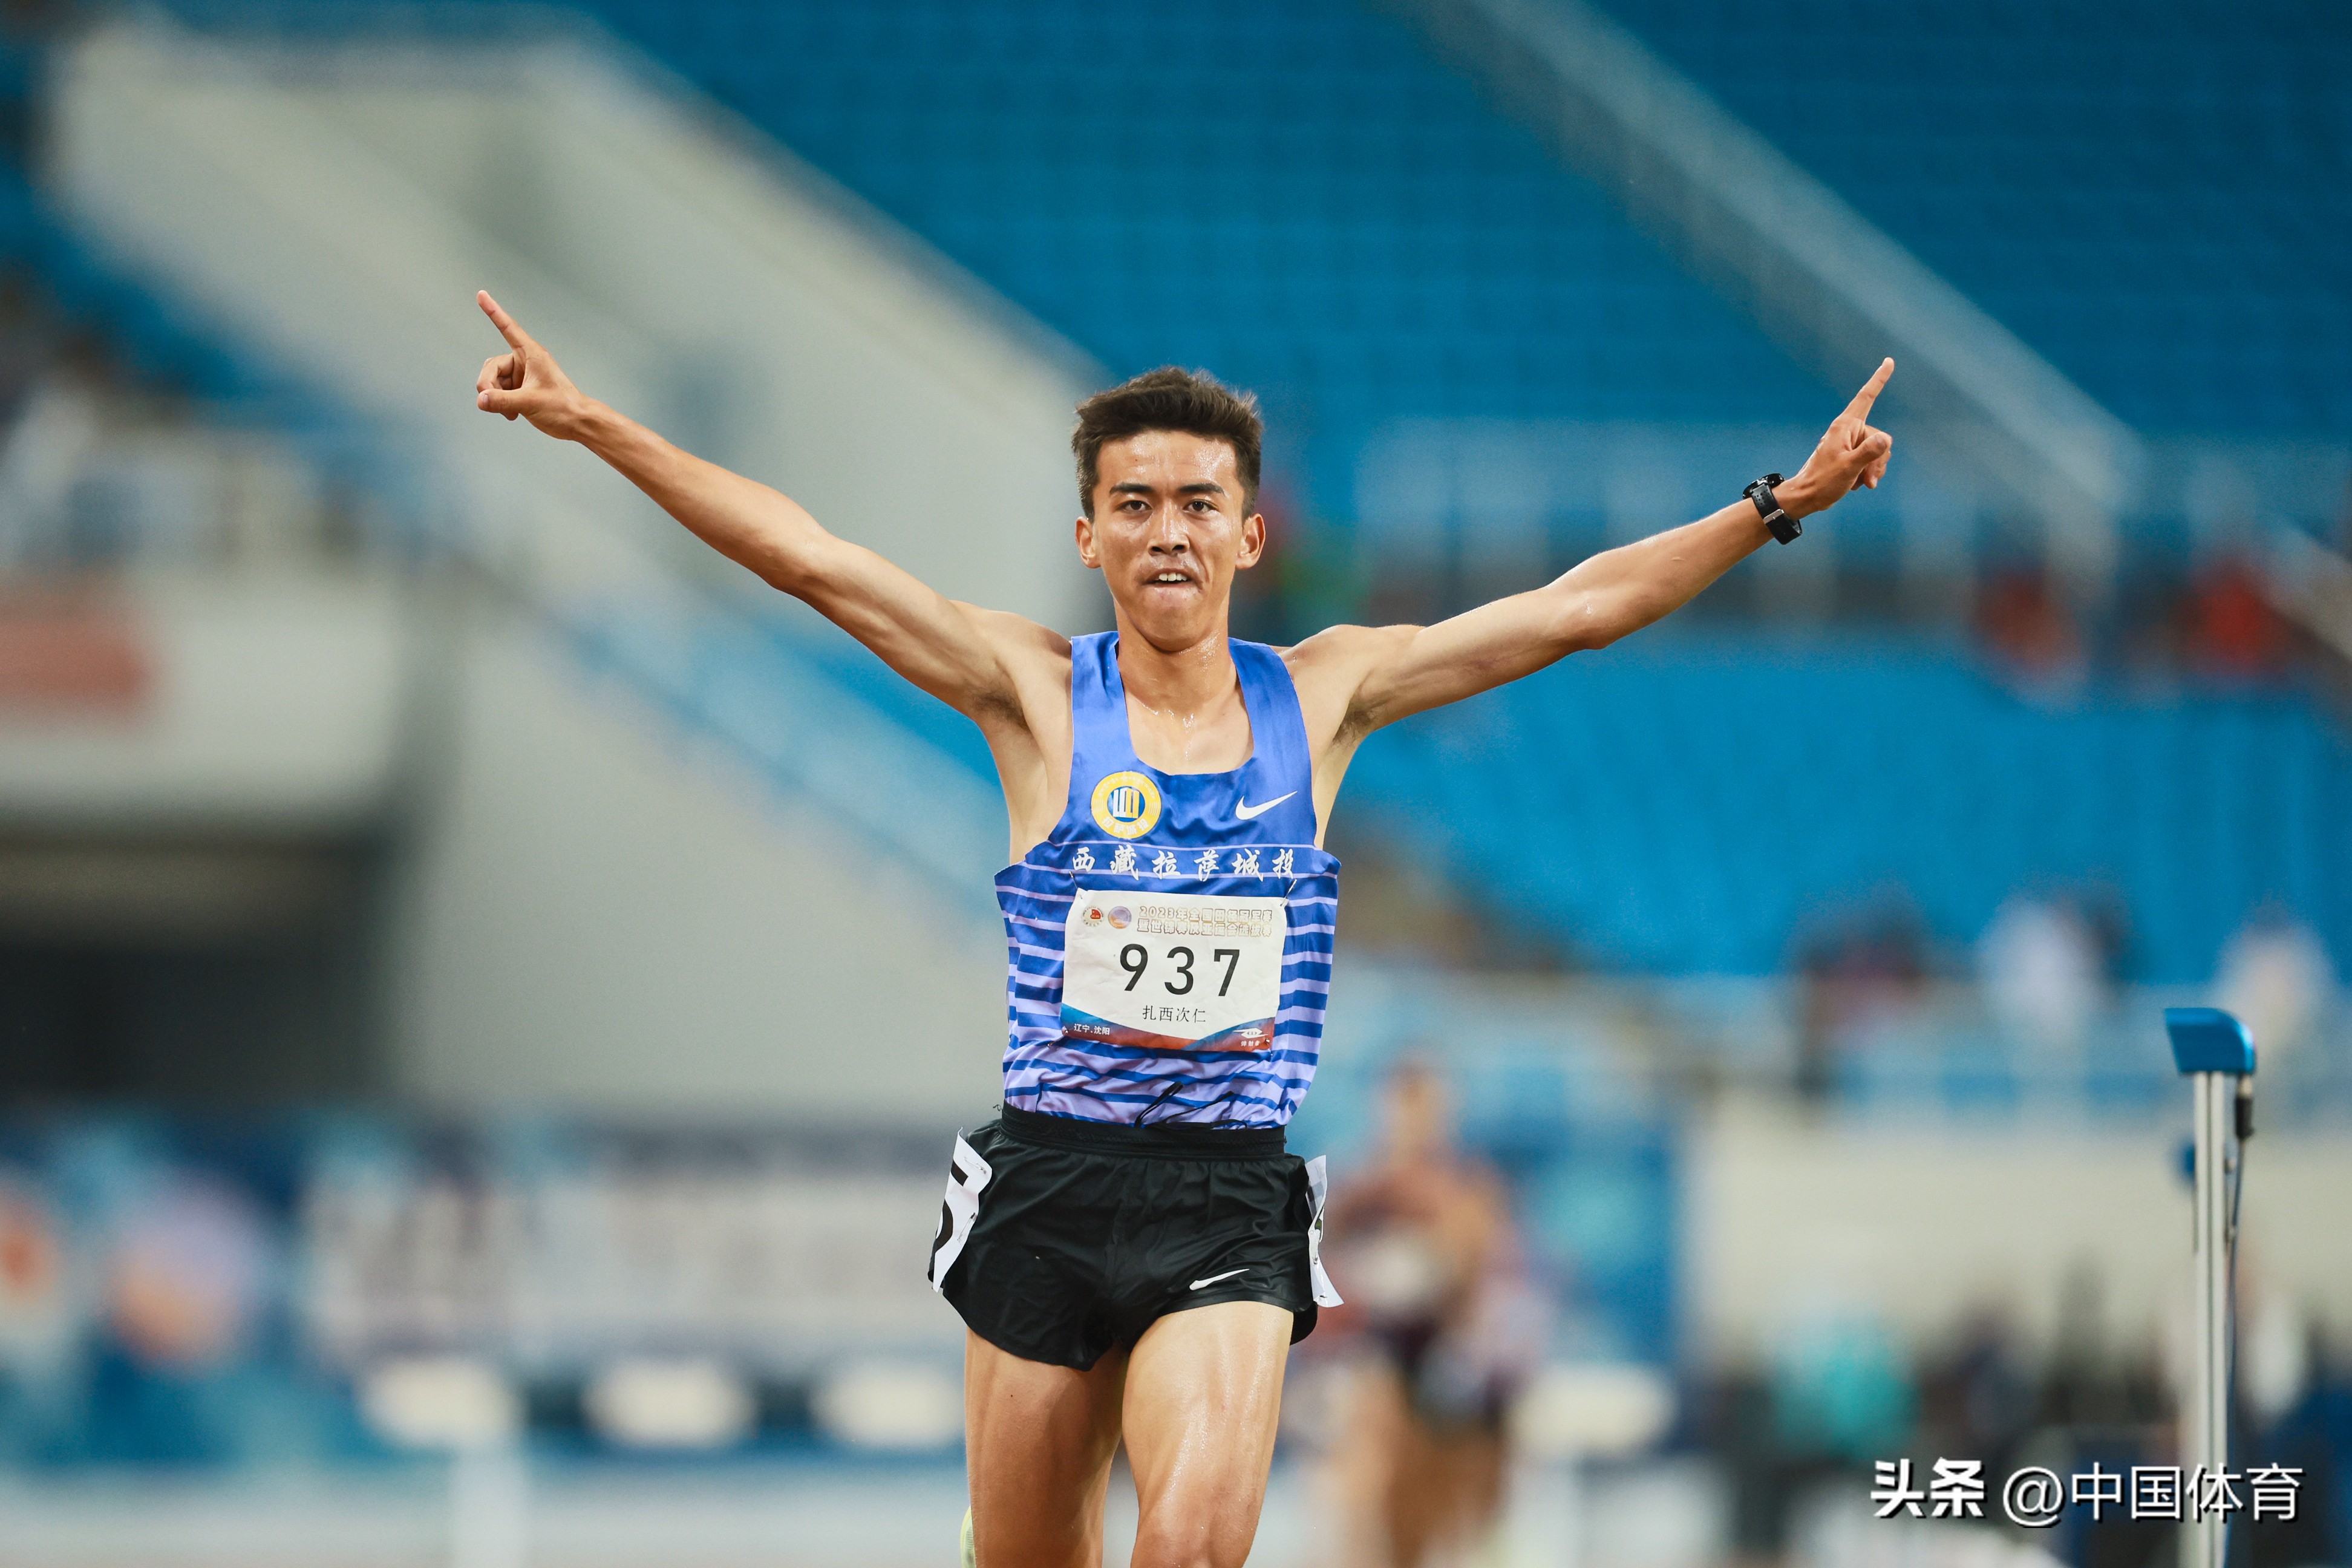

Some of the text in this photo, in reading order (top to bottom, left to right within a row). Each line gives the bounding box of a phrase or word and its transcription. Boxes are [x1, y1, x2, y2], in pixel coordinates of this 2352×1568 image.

[1073, 844, 1293, 882] 西藏拉萨城投
[1120, 943, 1240, 997] 937
[1142, 1005, 1206, 1023] 扎西次仁
